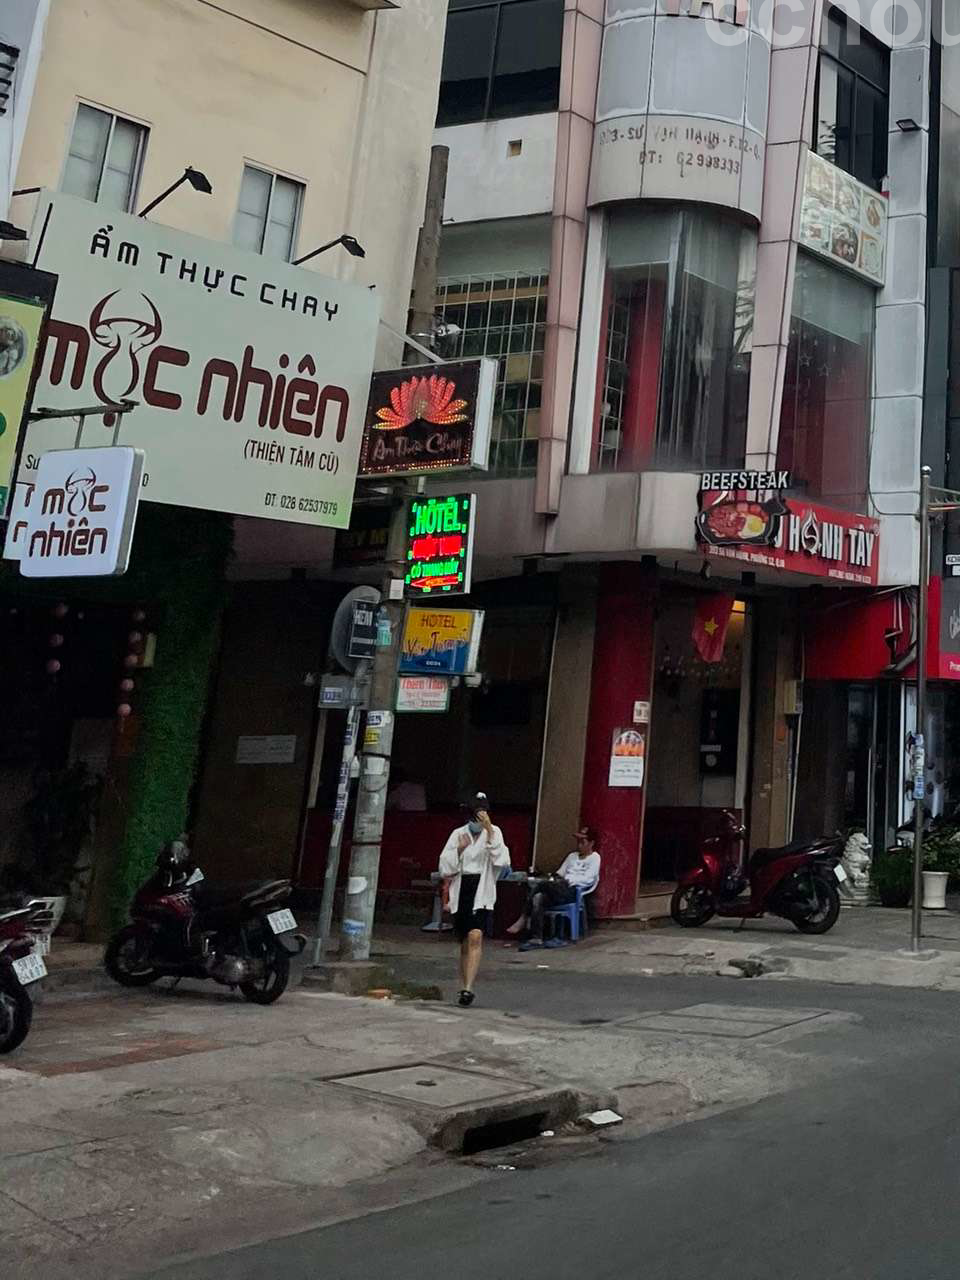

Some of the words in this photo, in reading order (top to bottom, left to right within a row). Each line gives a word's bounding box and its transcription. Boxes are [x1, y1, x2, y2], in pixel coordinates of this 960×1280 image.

[90, 225, 139, 266] ẨM
[157, 252, 247, 297] THỰC
[259, 282, 339, 321] CHAY
[197, 344, 349, 443] nhiên
[244, 438, 285, 466] (THIỆN
[290, 443, 315, 470] TÂM
[702, 470, 789, 490] BEEFSTEAK
[280, 495, 296, 509] 028
[299, 498, 338, 516] 62537979
[29, 517, 108, 557] nhiên
[848, 524, 875, 567] TÂY
